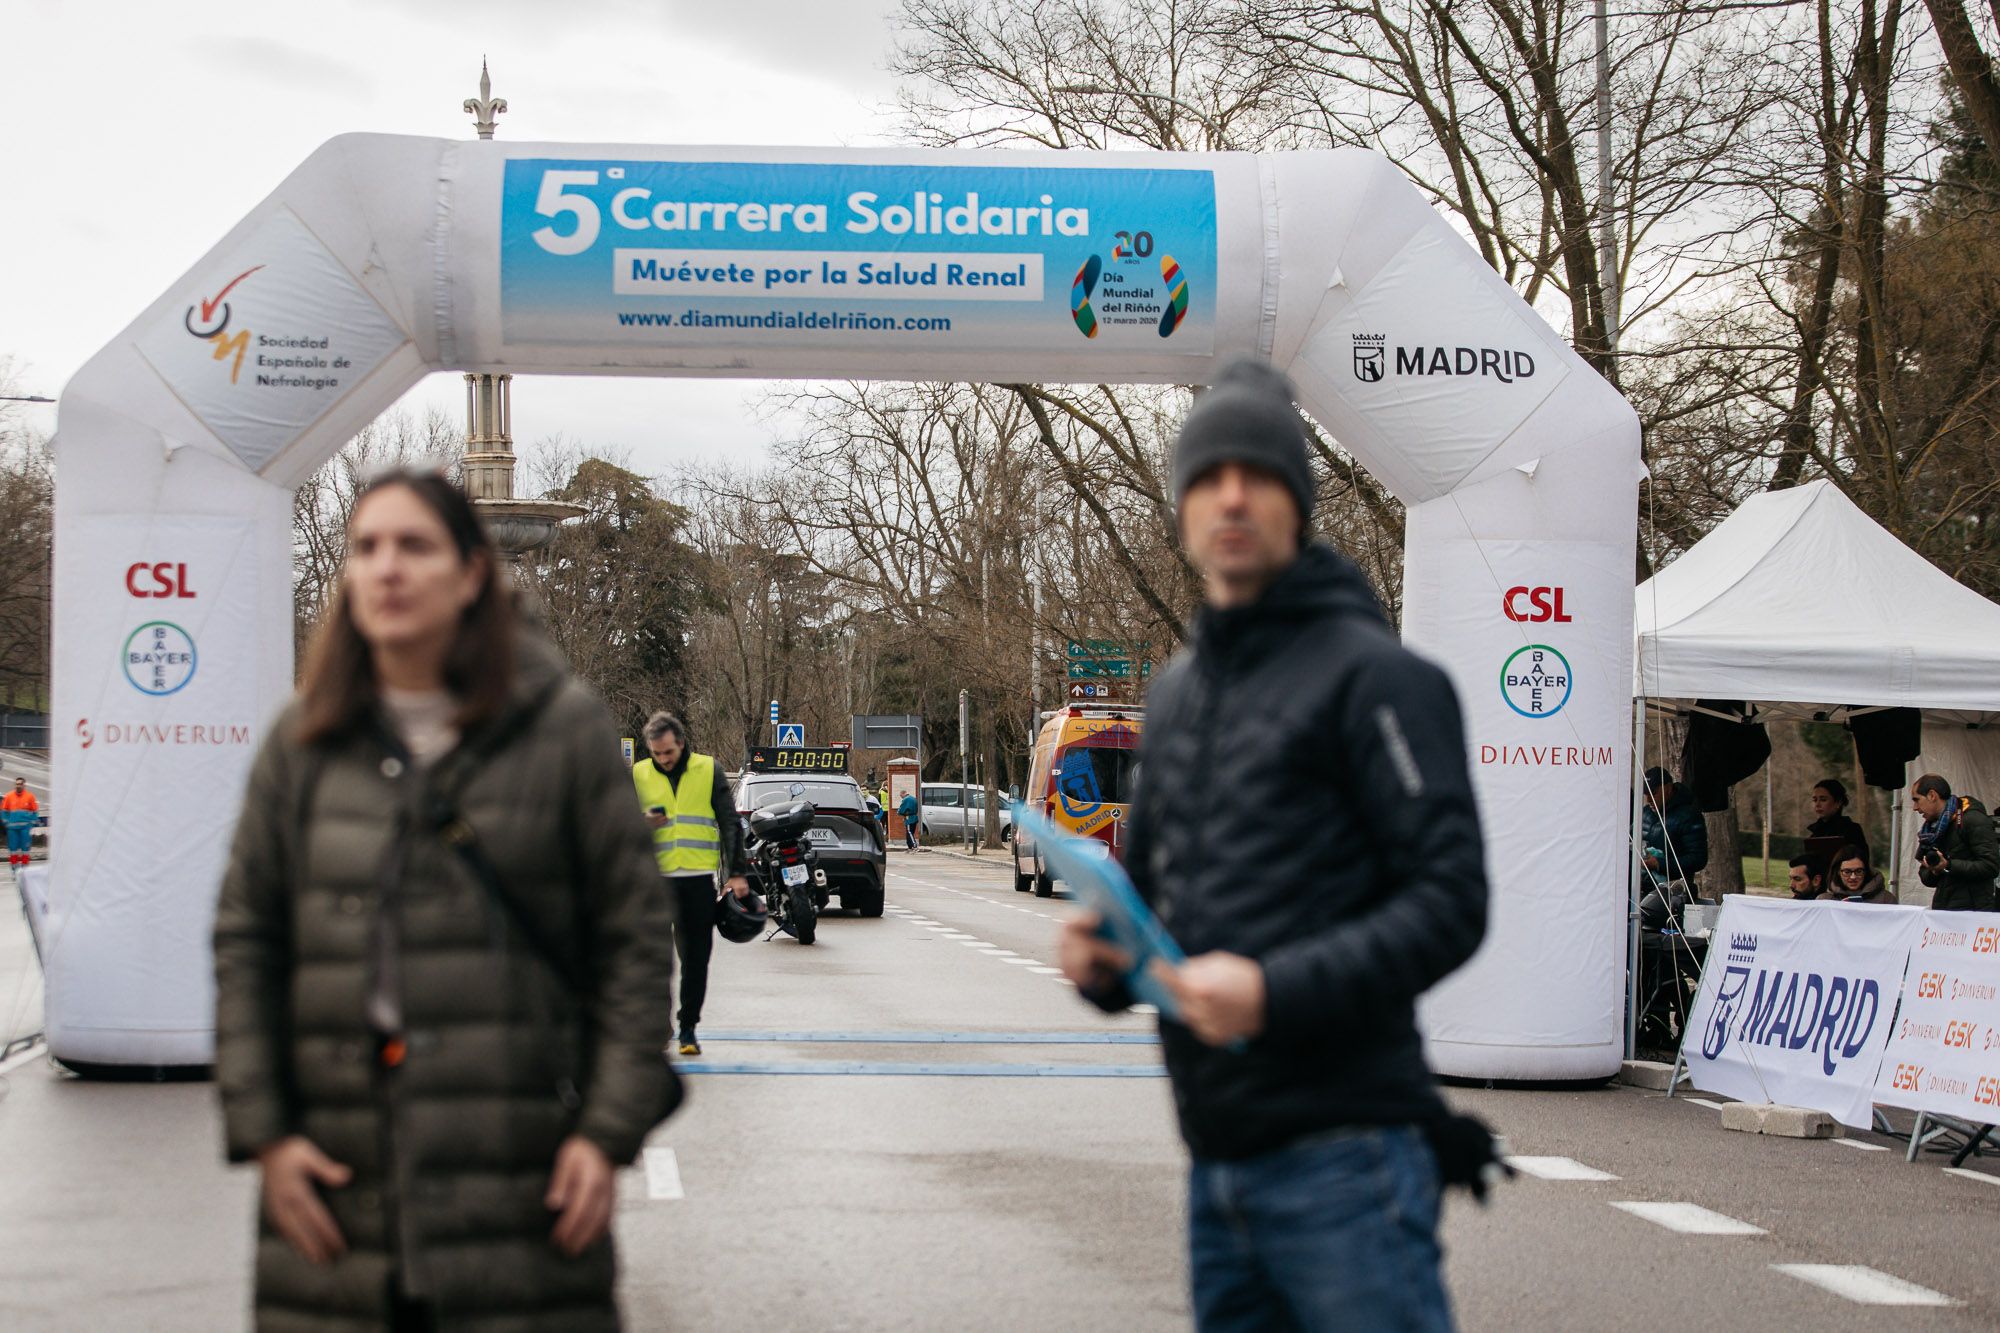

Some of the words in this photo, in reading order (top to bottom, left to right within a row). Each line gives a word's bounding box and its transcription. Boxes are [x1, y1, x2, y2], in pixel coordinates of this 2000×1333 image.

[610, 187, 827, 233] Carrera
[845, 191, 1089, 237] Solidaria
[1111, 230, 1154, 262] 20
[631, 259, 755, 284] Muévete
[765, 268, 812, 290] por
[822, 261, 847, 285] la
[858, 263, 937, 286] Salud
[947, 263, 1026, 288] Renal
[1103, 272, 1124, 283] Día
[1103, 288, 1154, 298] Mundial
[1102, 303, 1121, 313] del
[1125, 303, 1161, 313] Riñón
[617, 310, 951, 332] www.diamundialdelriñon.com
[1113, 317, 1138, 325] marzo
[1139, 317, 1158, 325] 2026
[259, 335, 328, 349] Sociedad
[258, 355, 327, 369] Española
[333, 356, 351, 369] de
[1396, 346, 1535, 384] MADRID
[125, 562, 197, 598] CSL
[1503, 586, 1572, 623] CSL
[130, 653, 191, 664] BAYER
[153, 627, 167, 689] BAYER
[1507, 675, 1566, 687] BAYER
[1531, 651, 1545, 712] BAYER
[105, 724, 250, 745] DIAVERUM
[1481, 745, 1613, 766] DIAVERUM
[1075, 810, 1112, 834] MADRID
[811, 830, 828, 838] NKK
[1930, 931, 1967, 946] DIAVERUM
[1918, 972, 1947, 999] GSK
[1958, 983, 1996, 1000] DIAVERUM
[1739, 969, 1879, 1076] MADRID
[1944, 1020, 1977, 1048] GSK
[1892, 1063, 1924, 1092] GSK
[1929, 1075, 1967, 1096] DIAVERUM
